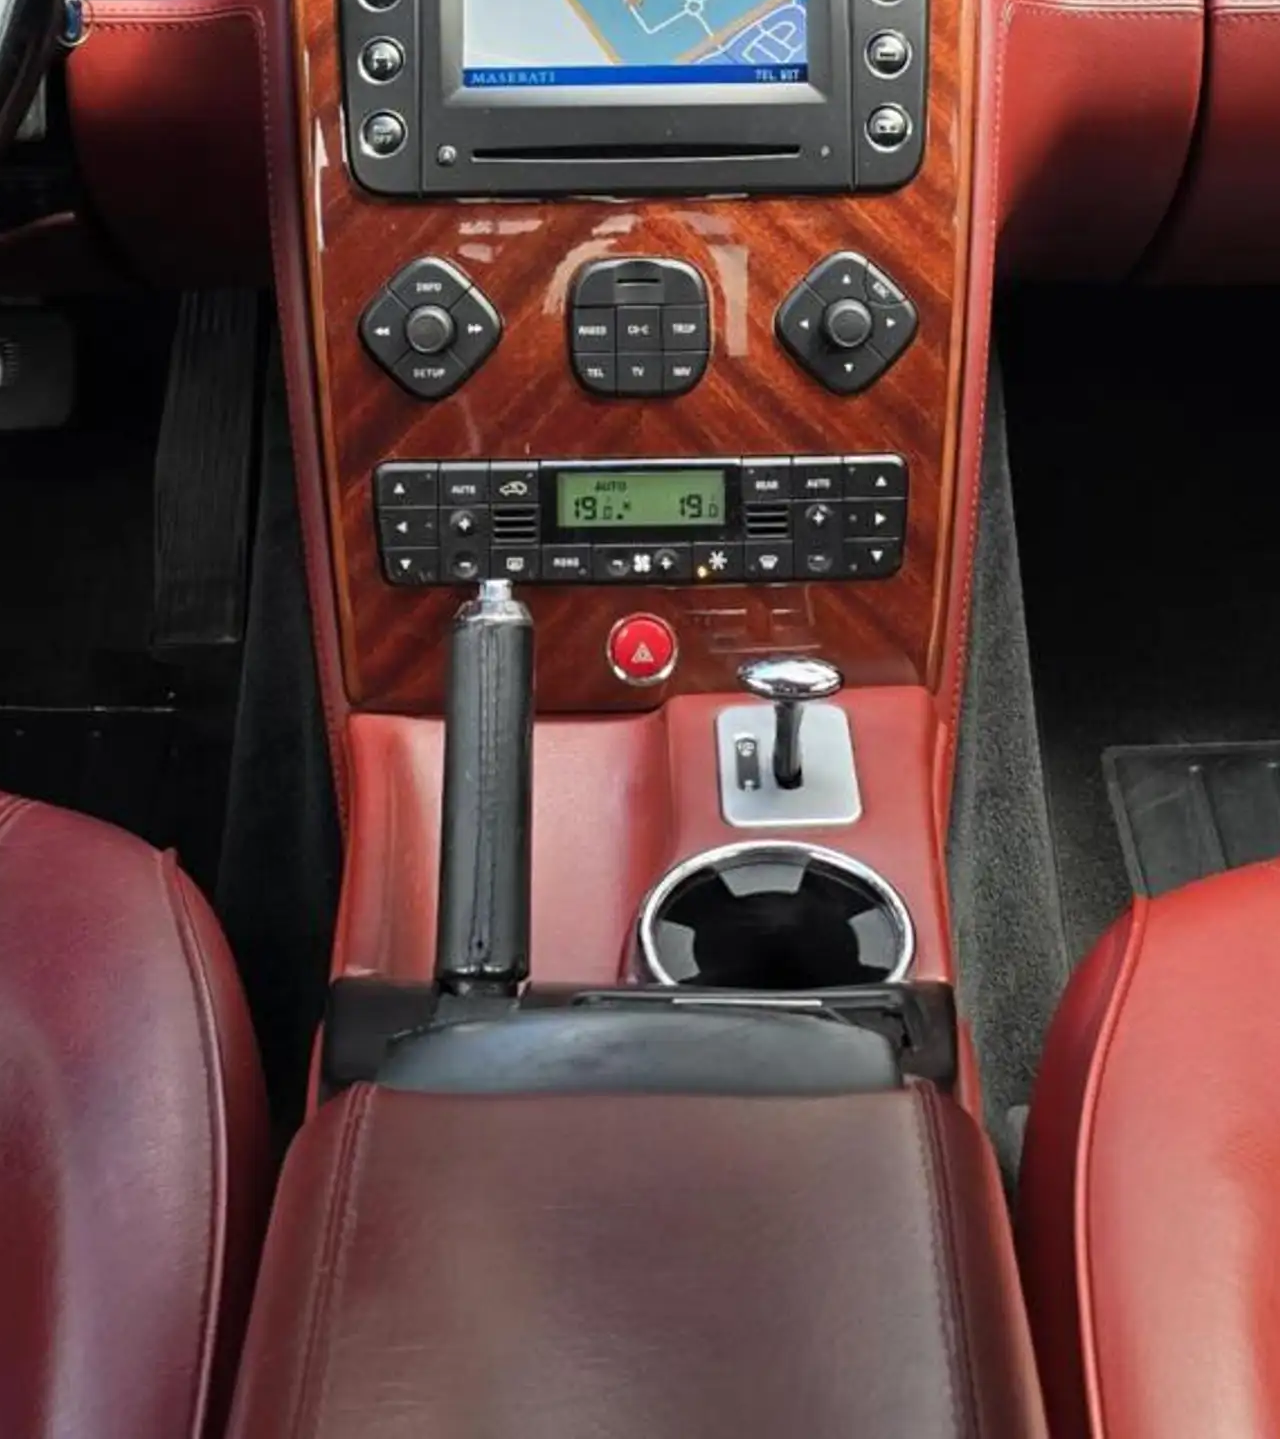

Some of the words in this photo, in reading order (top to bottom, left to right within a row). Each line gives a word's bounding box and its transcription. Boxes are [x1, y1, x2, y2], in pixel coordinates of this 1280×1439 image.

[469, 71, 557, 84] MASERATI
[416, 282, 442, 292] INFO
[672, 323, 696, 334] TRIP
[413, 368, 446, 379] SETUP
[587, 368, 604, 378] TEL
[632, 366, 645, 377] TV
[672, 366, 692, 377] NAV
[451, 484, 476, 495] AUTO
[594, 480, 627, 493] AUTO
[805, 478, 831, 490] AUTO
